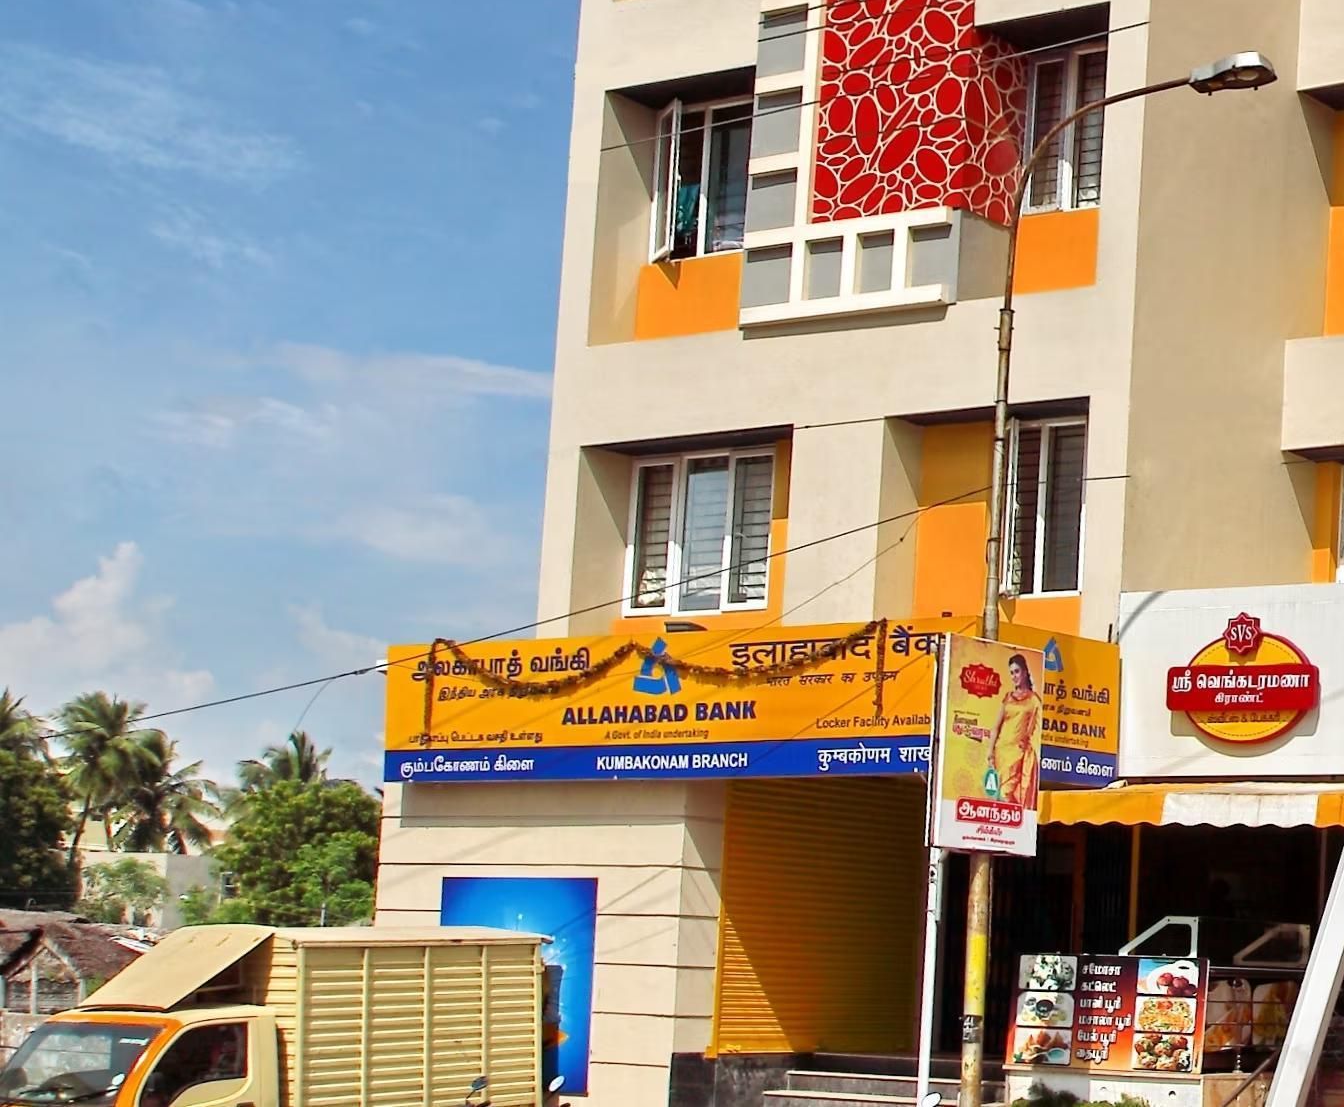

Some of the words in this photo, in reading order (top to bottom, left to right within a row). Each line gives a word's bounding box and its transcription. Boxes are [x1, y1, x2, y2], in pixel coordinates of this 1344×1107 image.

[1230, 624, 1253, 642] SVS
[530, 647, 590, 673] வங்கி
[1197, 670, 1310, 691] வெங்கடரமணா
[1071, 684, 1111, 705] வங்கி
[1214, 691, 1264, 706] கிராண்ட்
[561, 703, 688, 726] ALLAHABAD
[695, 700, 757, 722] BANK
[816, 717, 850, 729] Locker
[853, 715, 890, 729] Facility
[891, 714, 931, 726] Availab
[604, 731, 611, 740] A
[632, 729, 642, 740] of
[643, 729, 662, 740] India
[663, 728, 709, 740] undertaking
[1042, 718, 1068, 733] BAD
[1071, 723, 1107, 739] BANK
[400, 756, 490, 778] கும்பகோணம்
[493, 754, 534, 772] கிளை
[596, 754, 688, 771] KUMBAKONAM
[692, 753, 748, 769] BRANCH
[818, 742, 891, 771] कुम्बकोणम
[899, 745, 932, 762] शाख
[1041, 756, 1073, 772] ணம்
[1075, 756, 1114, 778] கிளை
[959, 801, 1021, 824] ஆனந்தம்
[1082, 962, 1121, 976] சமோசா
